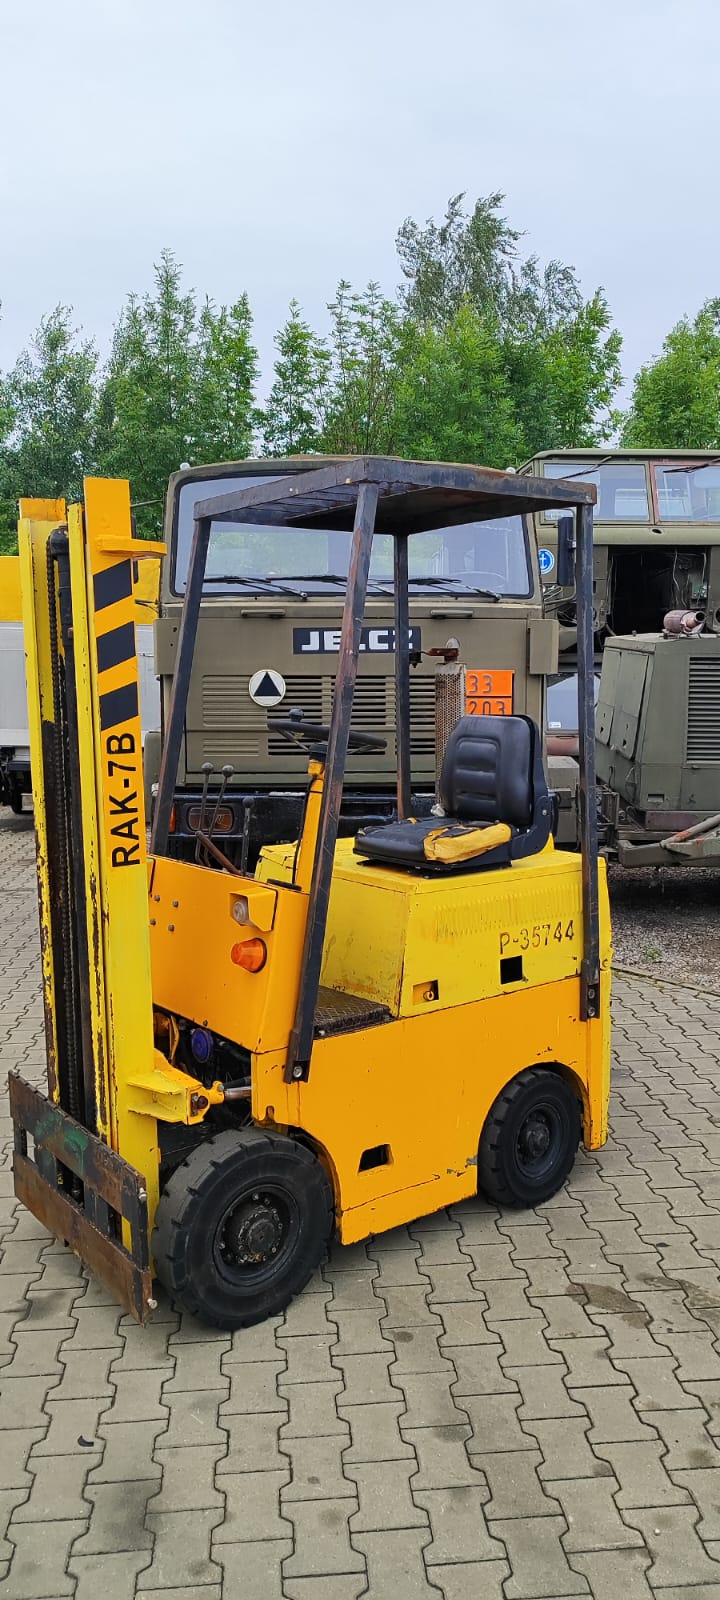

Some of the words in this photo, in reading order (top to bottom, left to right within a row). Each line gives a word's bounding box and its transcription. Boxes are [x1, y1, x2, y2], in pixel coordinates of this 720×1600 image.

[302, 629, 413, 651] JEC
[469, 674, 493, 694] 33
[106, 733, 140, 868] RAK-7B
[500, 919, 574, 955] P-35744
